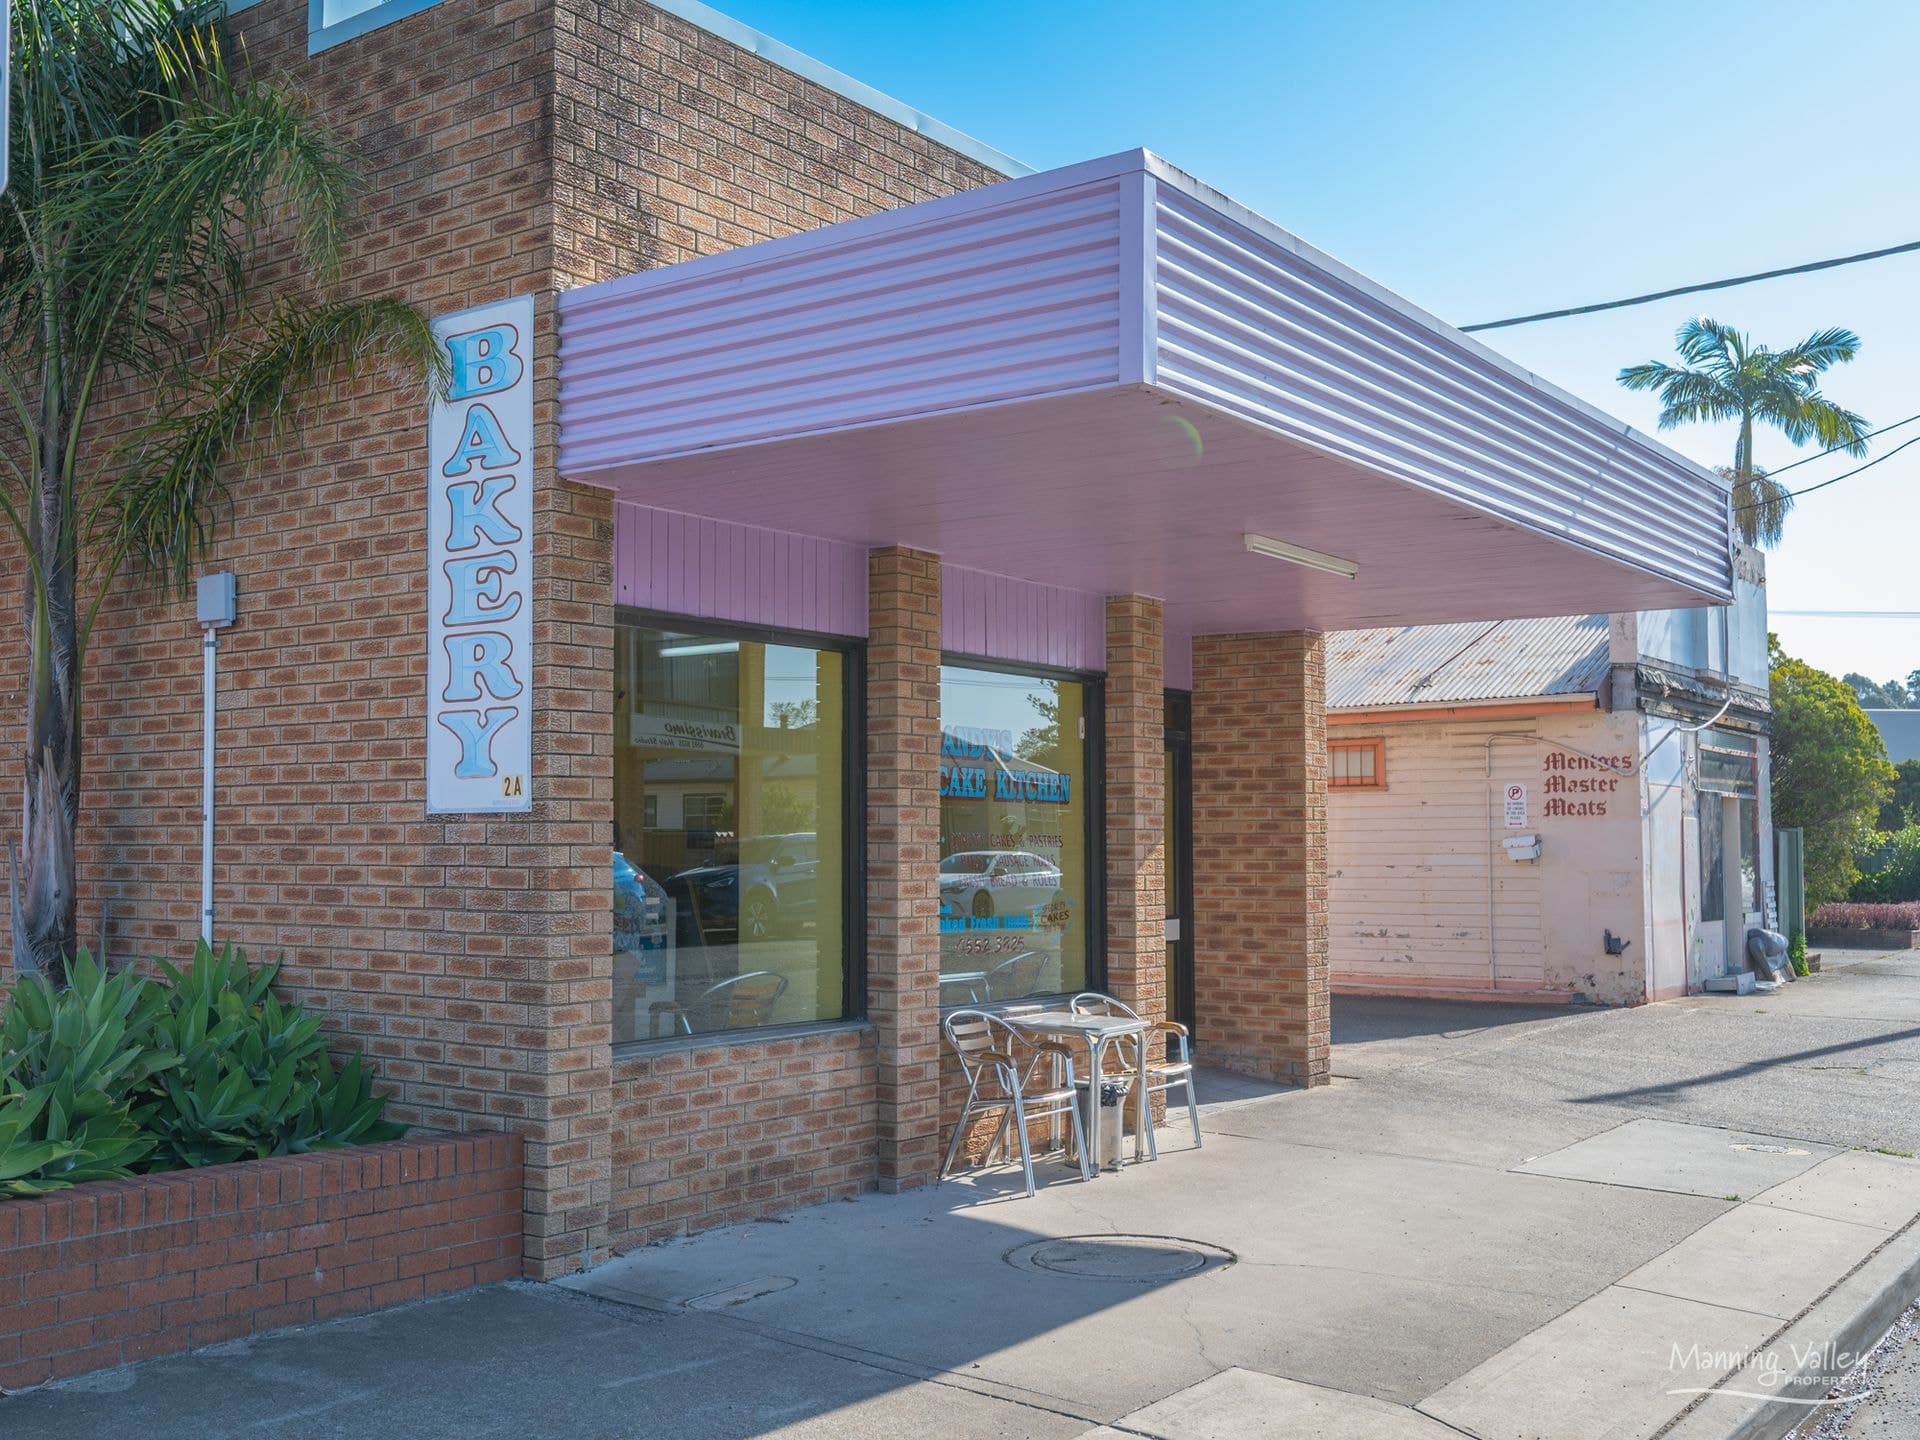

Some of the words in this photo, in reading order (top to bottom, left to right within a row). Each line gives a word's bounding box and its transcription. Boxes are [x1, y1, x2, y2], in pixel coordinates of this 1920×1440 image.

[437, 323, 524, 779] BAKERY
[504, 776, 522, 797] 2A
[939, 766, 987, 801] CAKE
[993, 769, 1070, 804] KITCHEN
[1543, 775, 1619, 794] Master
[1543, 798, 1607, 817] Meats
[990, 833, 1015, 849] CAKES
[1028, 835, 1064, 849] PASTRIES
